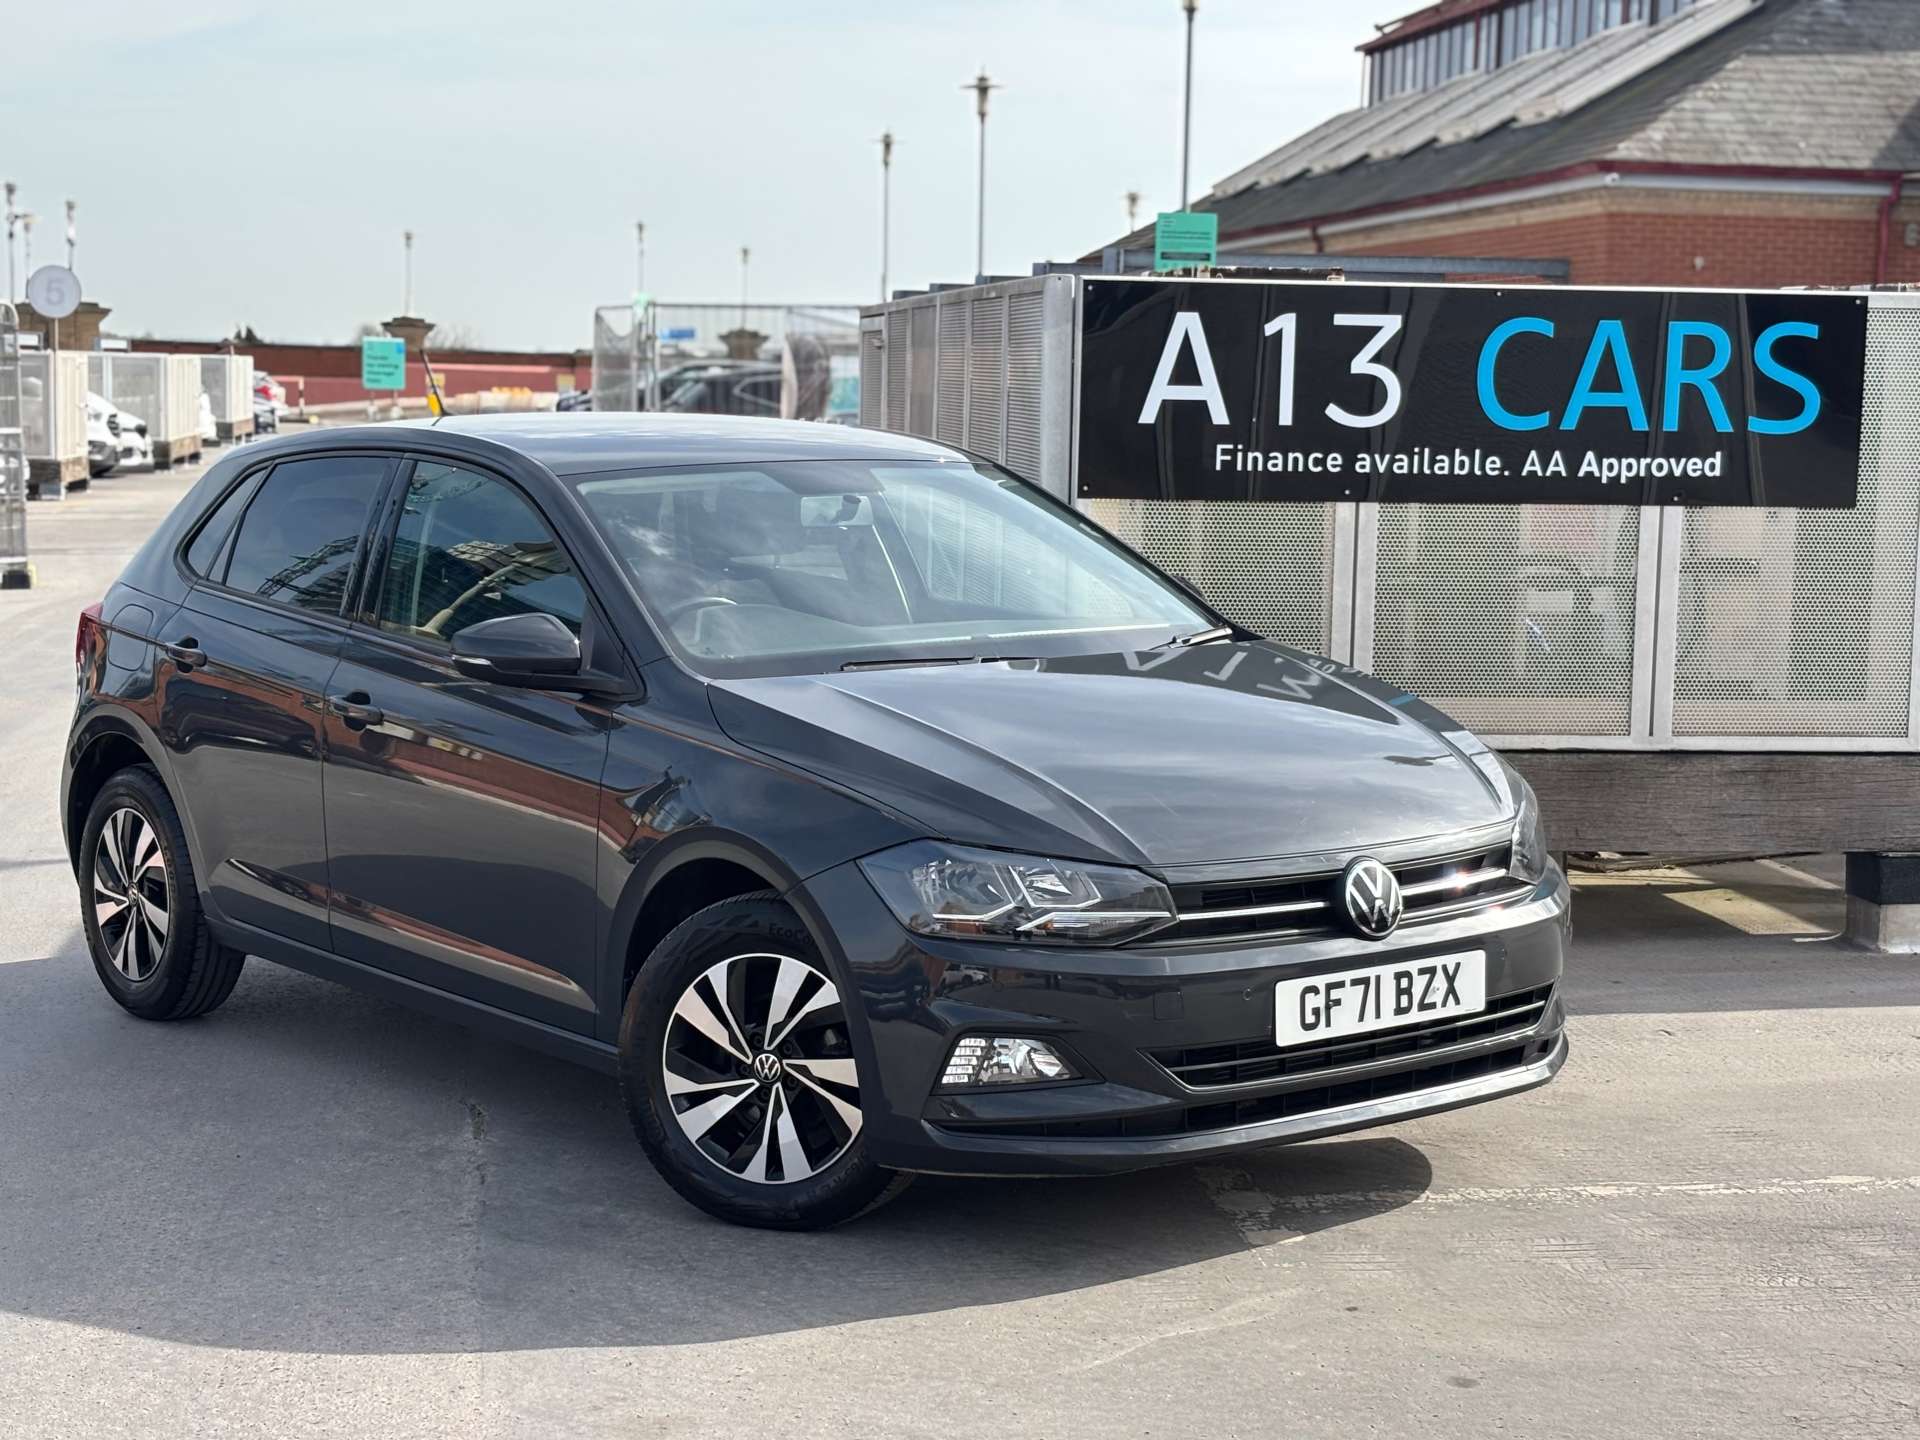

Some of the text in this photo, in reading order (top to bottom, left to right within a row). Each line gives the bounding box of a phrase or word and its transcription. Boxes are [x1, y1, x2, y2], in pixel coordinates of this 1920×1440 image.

[46, 277, 65, 306] 5
[1137, 311, 1821, 435] A13 CARS
[1215, 444, 1722, 484] Finance available. AA Approved
[1299, 961, 1461, 1032] GF71 BZX
